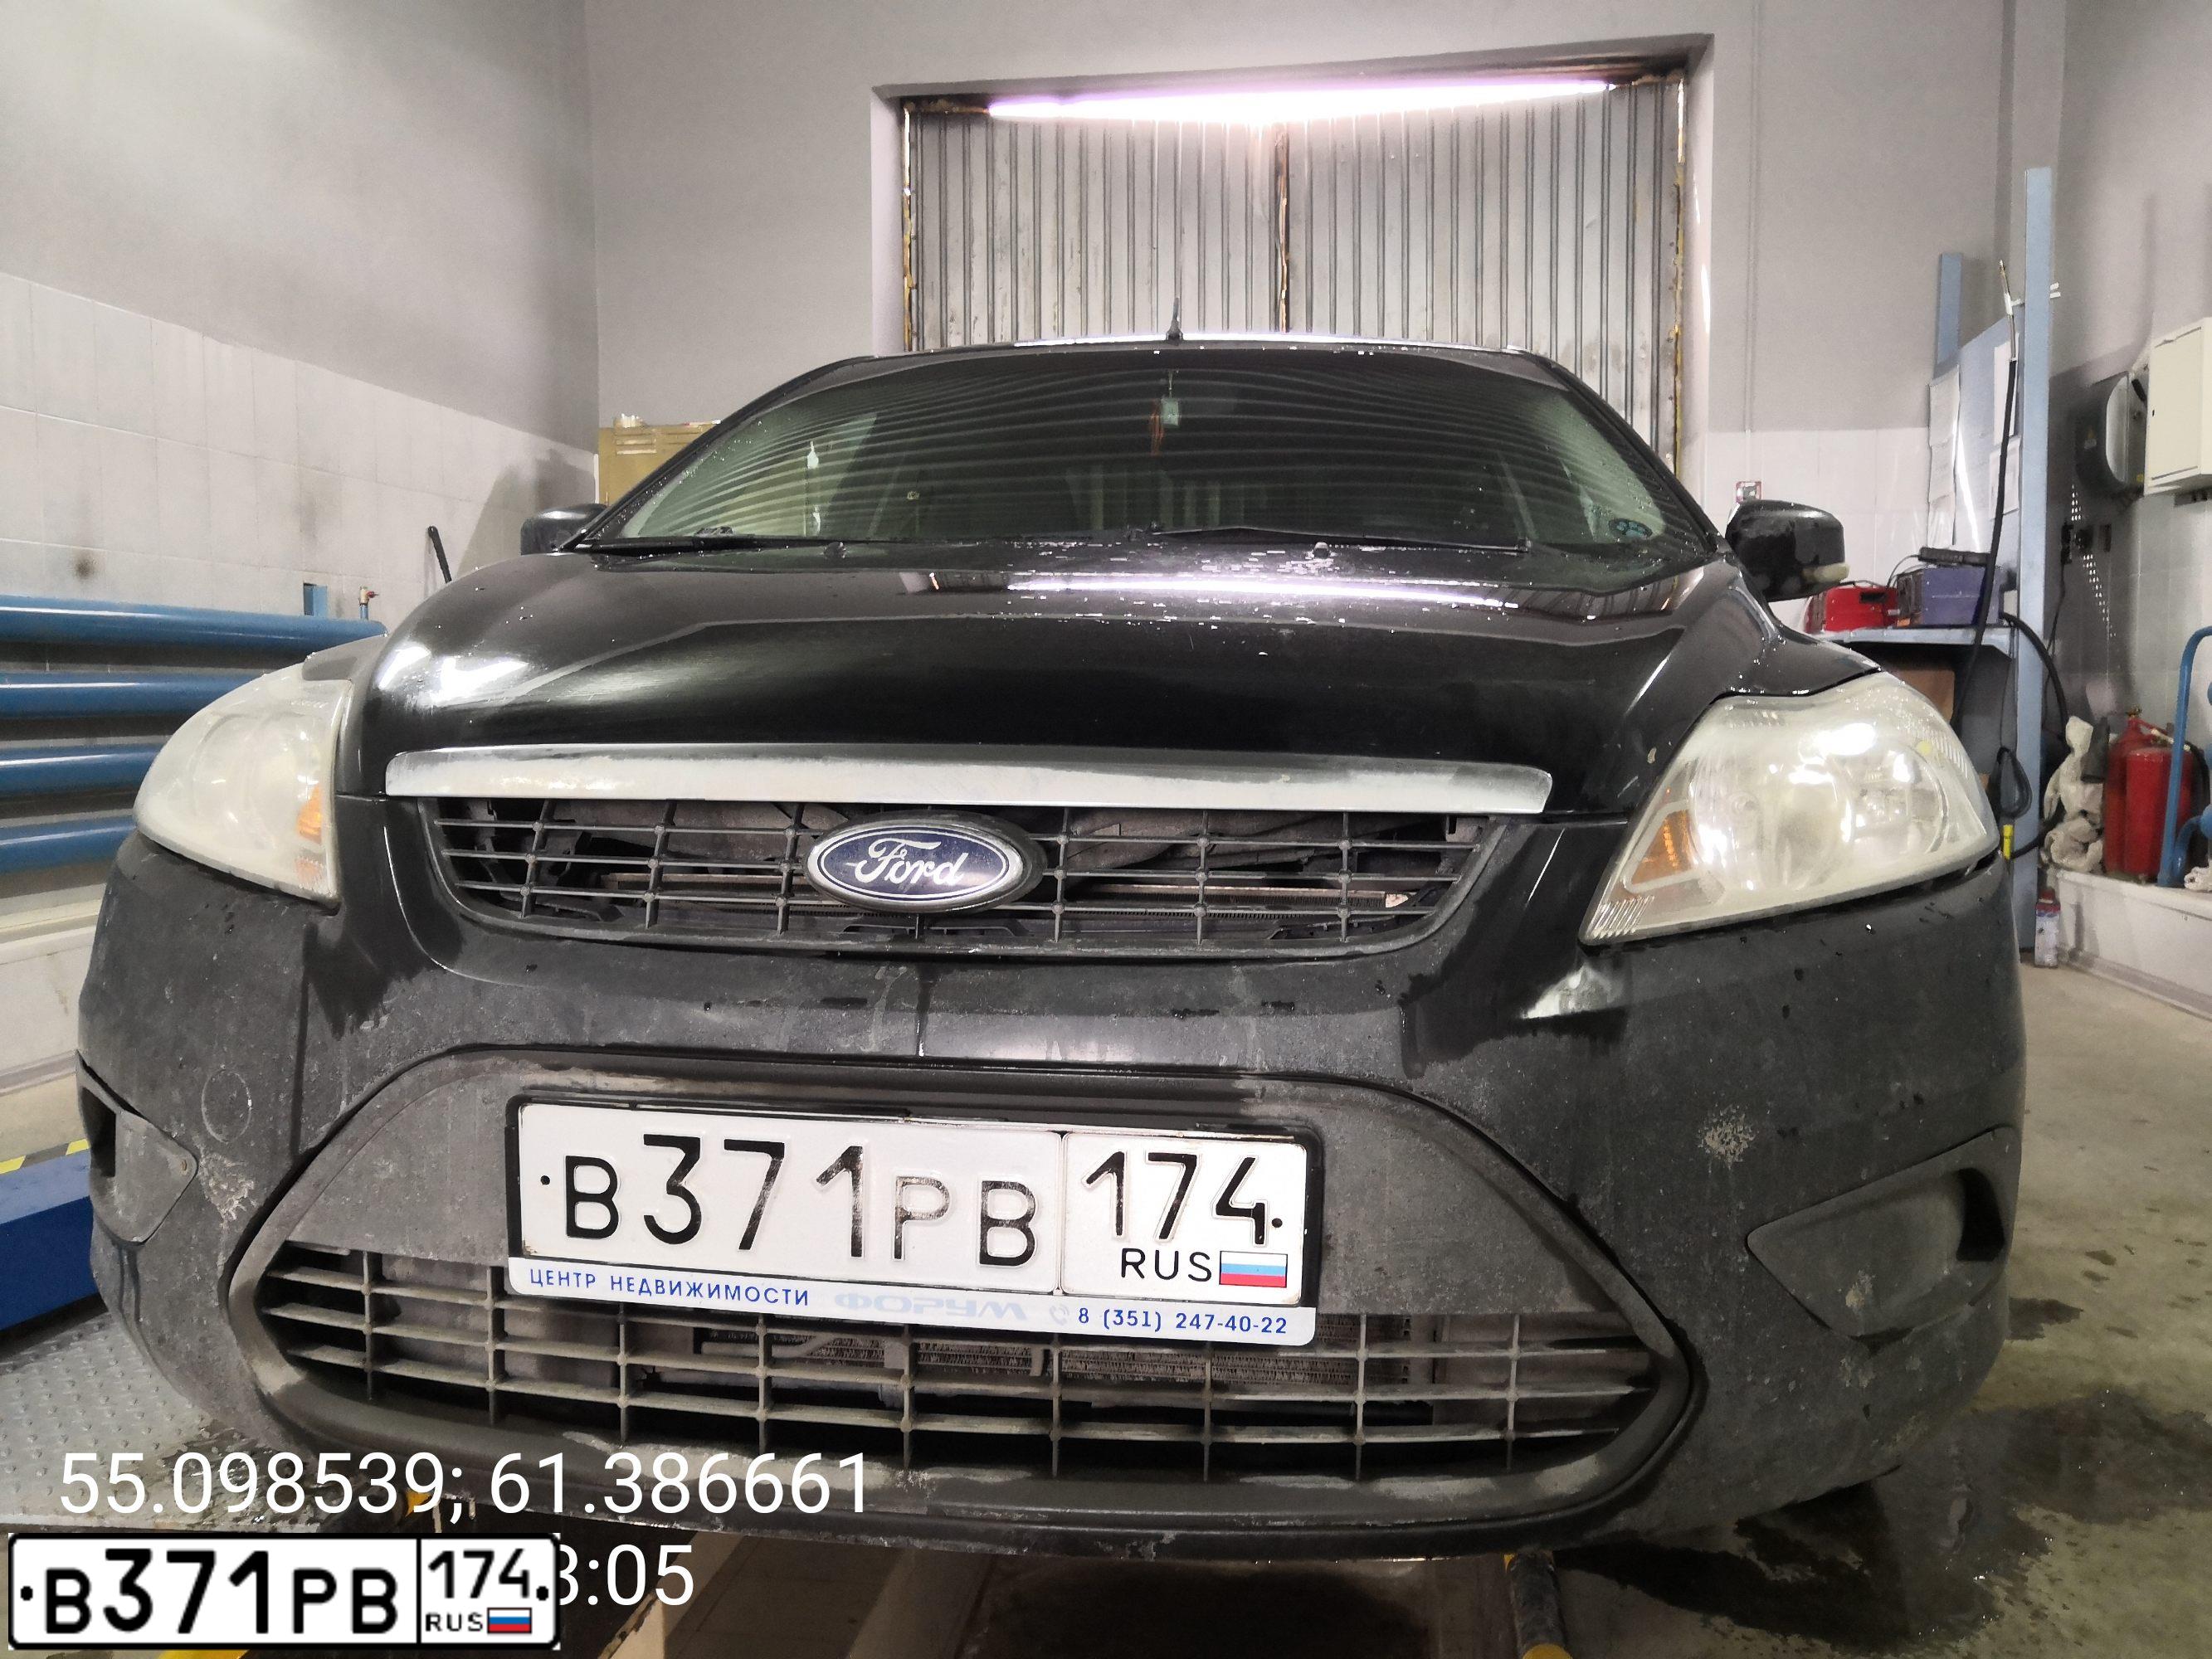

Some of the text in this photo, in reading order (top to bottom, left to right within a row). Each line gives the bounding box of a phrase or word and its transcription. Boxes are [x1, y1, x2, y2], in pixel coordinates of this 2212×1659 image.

[845, 838, 969, 886] Ford
[1086, 1151, 1265, 1245] 174
[1121, 1248, 1212, 1282] RUS
[530, 1267, 1288, 1334] ЦЕНТР НЕДВИЖИМОСТИ ФОРУМ 8 (351) 247-40-22
